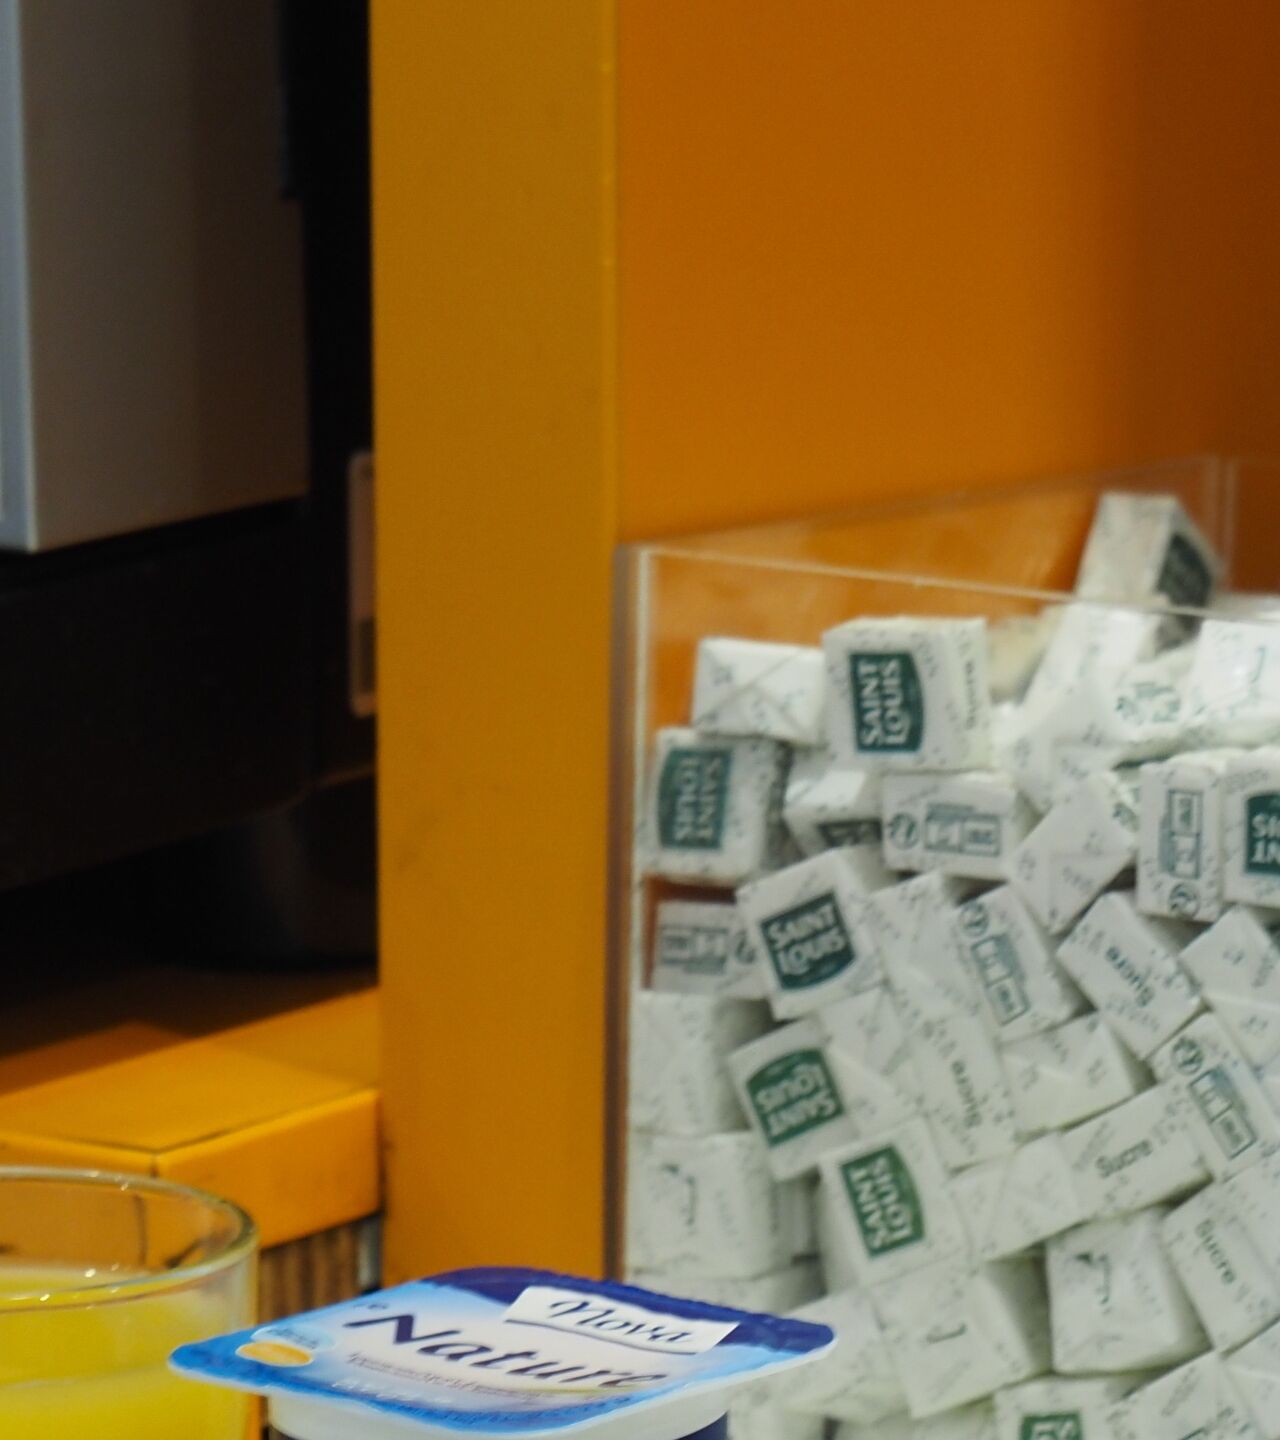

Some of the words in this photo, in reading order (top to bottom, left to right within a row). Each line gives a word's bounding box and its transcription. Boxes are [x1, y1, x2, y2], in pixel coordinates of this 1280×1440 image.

[859, 660, 882, 747] SAINT
[881, 659, 910, 745] LOUIS
[765, 901, 837, 950] SAINT
[777, 924, 847, 978] LOUIS
[754, 1061, 823, 1112] LOUIS
[766, 1090, 840, 1138] SAINT
[848, 1166, 891, 1251] SAINT
[868, 1156, 913, 1244] LOUIS
[343, 1314, 668, 1388] Nature
[549, 1299, 693, 1343] Nova
